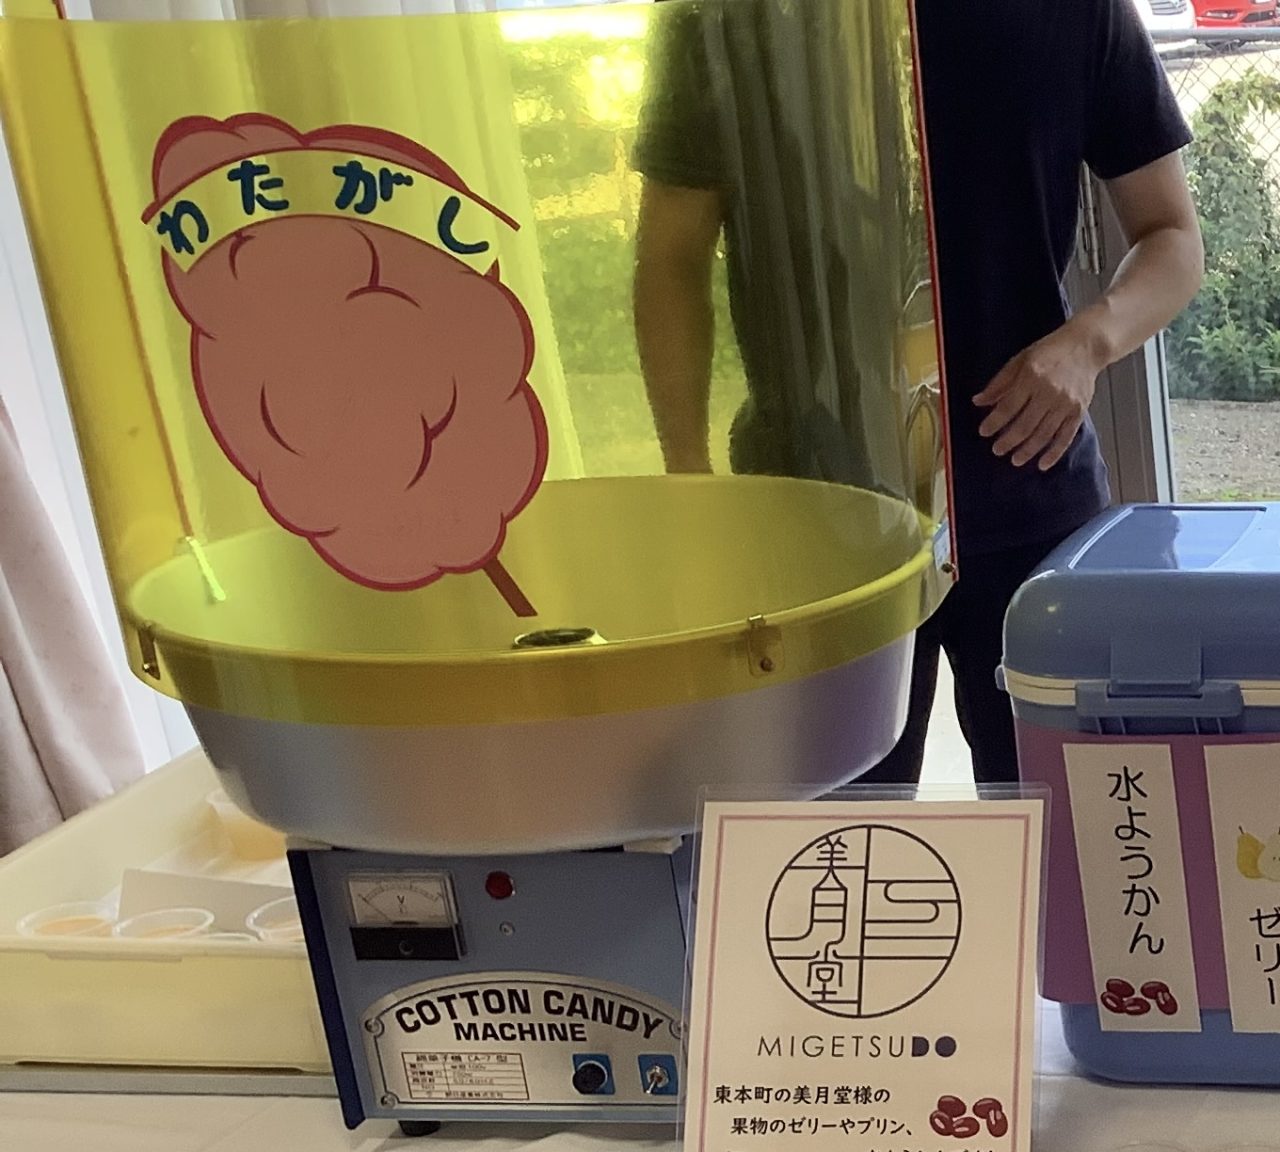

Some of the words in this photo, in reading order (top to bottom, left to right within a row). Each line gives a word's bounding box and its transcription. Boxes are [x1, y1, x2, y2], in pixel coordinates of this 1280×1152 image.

[157, 160, 489, 255] わたがし
[1107, 765, 1164, 955] 水ようかん
[395, 988, 532, 1033] COTTON
[543, 990, 664, 1039] CANDY
[454, 1022, 588, 1042] MACHINE
[757, 1035, 957, 1058] MIGETSUDO
[713, 1085, 891, 1105] 東本町の美月堂様の
[730, 1117, 912, 1135] 果物のゼリーやプリン、
